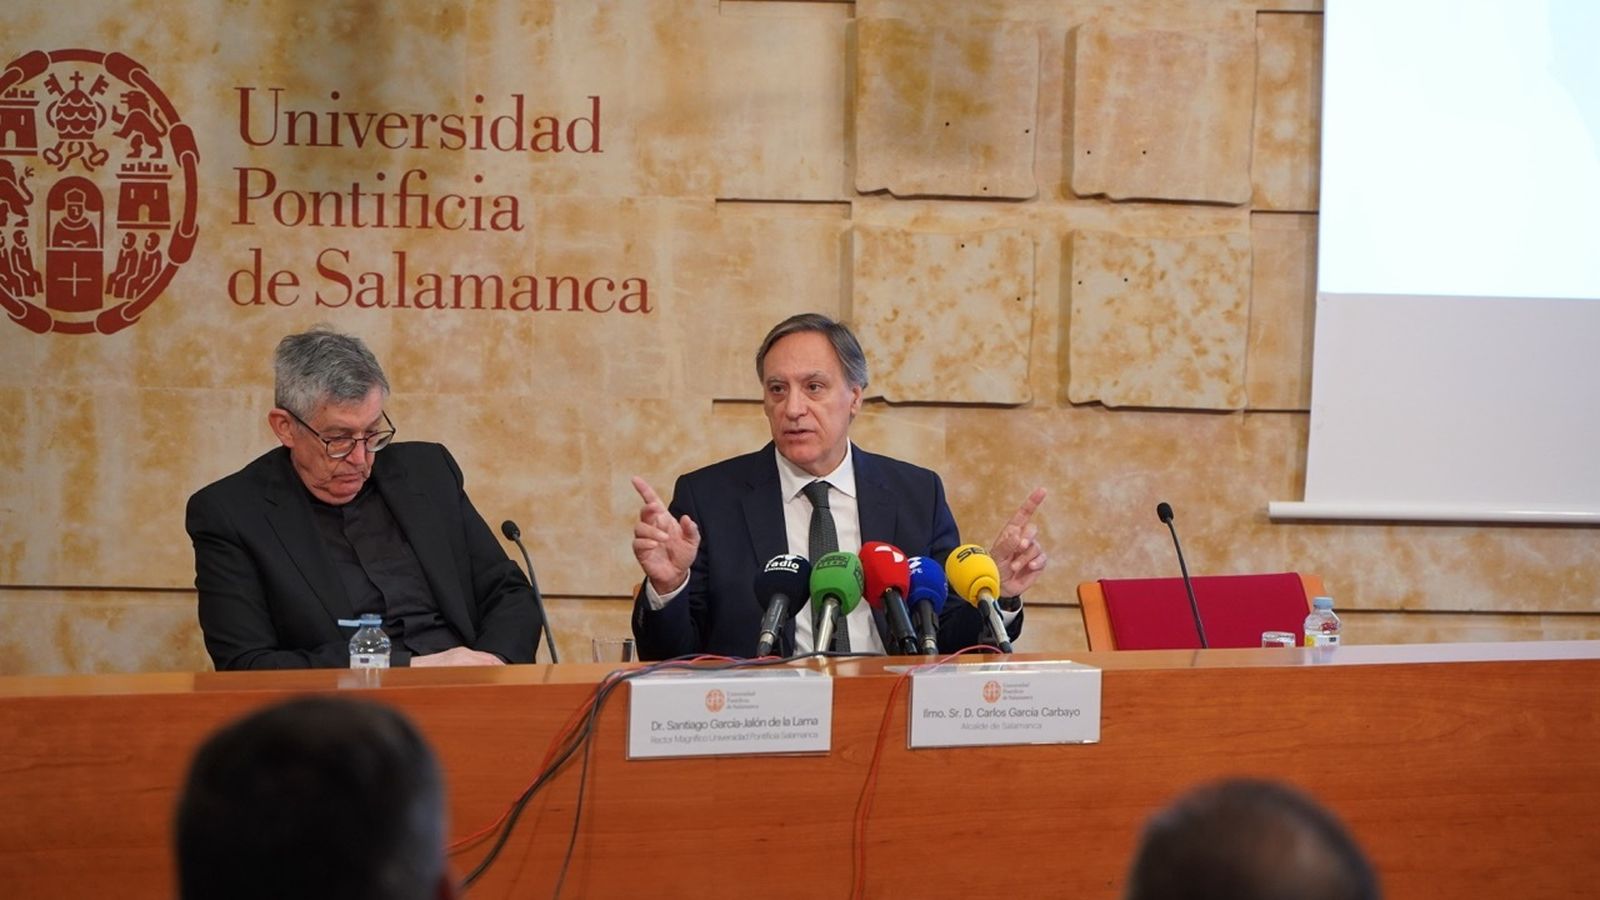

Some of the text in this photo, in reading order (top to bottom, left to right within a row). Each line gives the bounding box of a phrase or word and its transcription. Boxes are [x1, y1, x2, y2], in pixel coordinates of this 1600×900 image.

[233, 87, 604, 153] Universidad
[230, 167, 525, 231] Pontificia
[227, 247, 655, 314] de Salamanca
[765, 560, 800, 570] radio
[948, 707, 962, 718] Sr.
[963, 707, 974, 718] D.
[976, 707, 1006, 718] Carlos
[1040, 706, 1081, 719] Carbayo
[651, 720, 665, 731] Dr.
[666, 719, 709, 732] Santiago
[768, 716, 781, 727] de
[783, 715, 791, 727] la
[792, 716, 819, 727] Lama
[960, 721, 1042, 730] Alcalde de Salamanca
